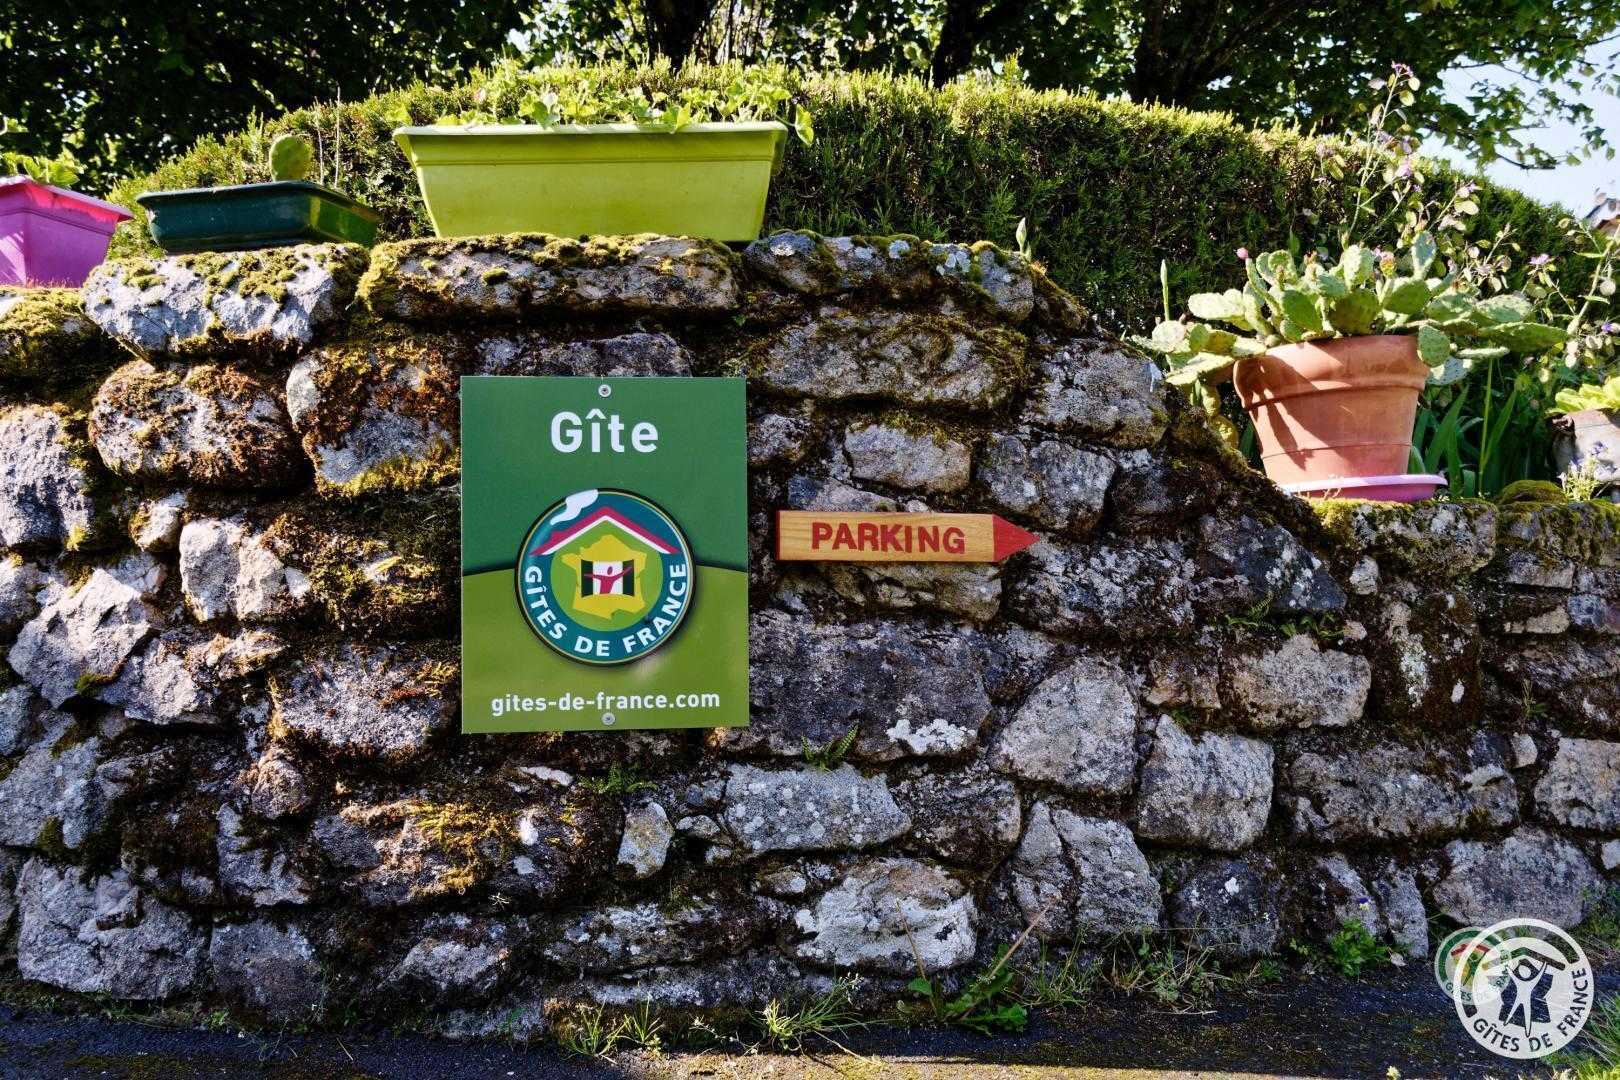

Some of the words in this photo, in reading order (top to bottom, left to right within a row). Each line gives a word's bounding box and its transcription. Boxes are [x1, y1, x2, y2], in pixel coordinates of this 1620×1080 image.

[550, 408, 659, 453] Gîte
[811, 522, 966, 555] PARKING
[524, 565, 568, 640] GÎTES
[574, 635, 610, 657] DE
[623, 563, 687, 654] FRANCE
[491, 692, 721, 717] gites-de-france.com
